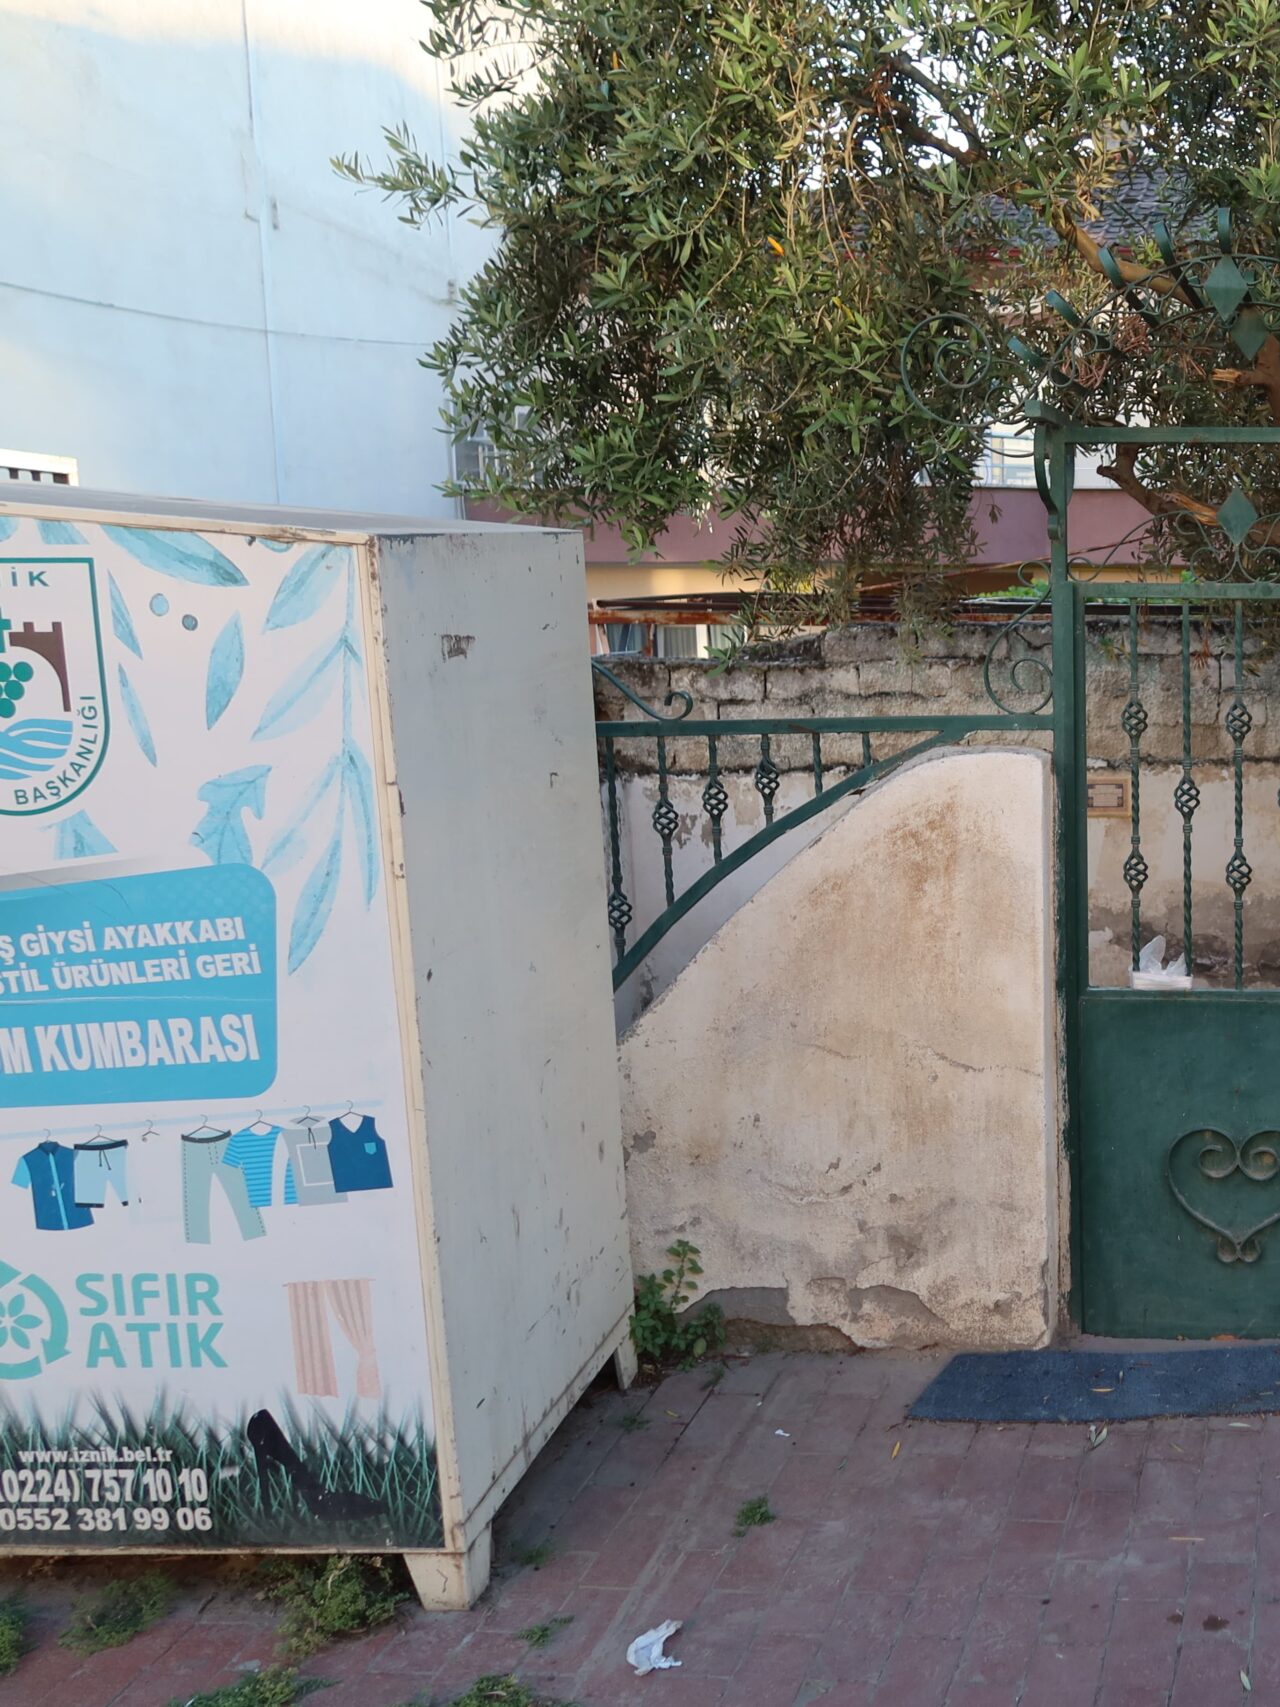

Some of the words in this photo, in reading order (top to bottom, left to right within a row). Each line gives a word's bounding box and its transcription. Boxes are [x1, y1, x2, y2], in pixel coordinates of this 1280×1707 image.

[14, 696, 98, 805] BAŞKANLIĞI
[20, 920, 96, 957] GİYSİ
[103, 916, 246, 951] AYAKKABI
[0, 961, 49, 995] TİL
[51, 953, 192, 990] ÜRÜNLERİ
[196, 943, 262, 979] GERİ
[34, 1013, 260, 1073] KUMBARASI
[75, 1272, 223, 1317] SIFIR
[86, 1322, 229, 1369] ATIK
[18, 1446, 173, 1464] www.iznik.bel.tr
[85, 1468, 135, 1502] 757
[143, 1467, 173, 1502] 10
[178, 1467, 208, 1502] 10
[0, 1507, 71, 1531] 0552
[76, 1507, 127, 1531] 381
[133, 1507, 170, 1531] 99
[176, 1507, 213, 1531] 06
